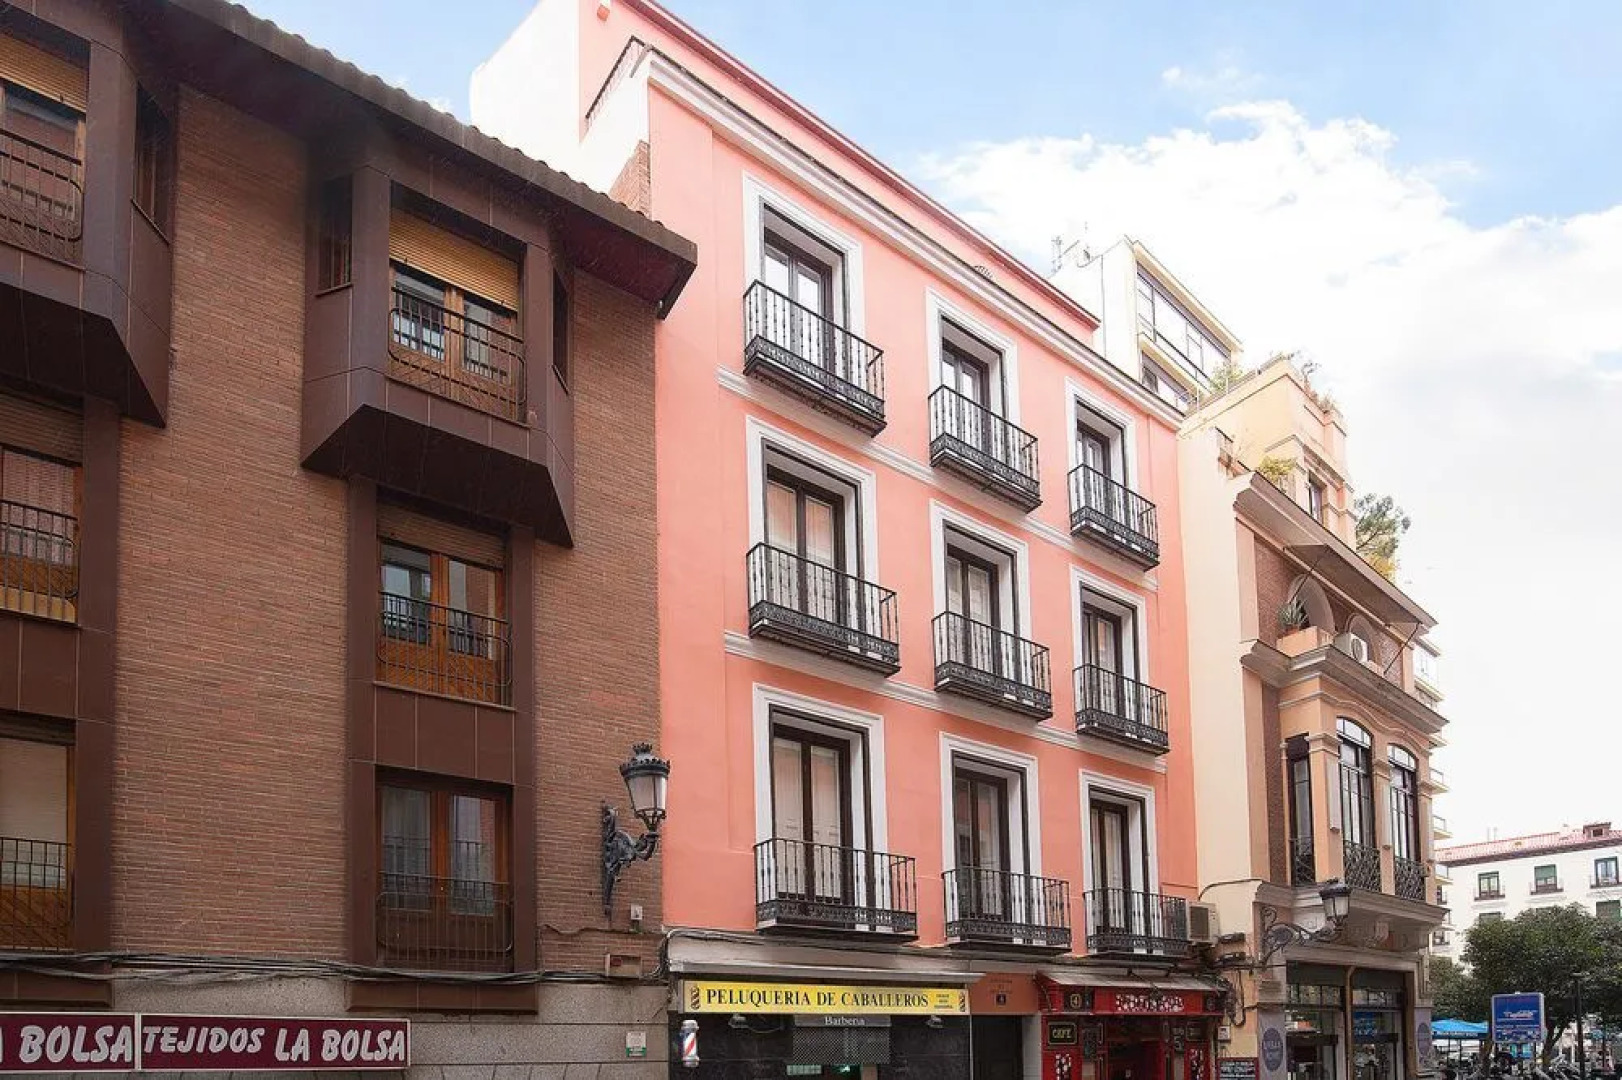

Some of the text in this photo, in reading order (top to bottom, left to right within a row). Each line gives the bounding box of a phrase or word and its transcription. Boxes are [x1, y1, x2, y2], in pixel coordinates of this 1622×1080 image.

[706, 989, 929, 1008] PELUQUERIA DE CABALLEROS
[19, 1025, 133, 1064] BOLSA
[143, 1026, 405, 1062] TEJIDOS LA BOLSA
